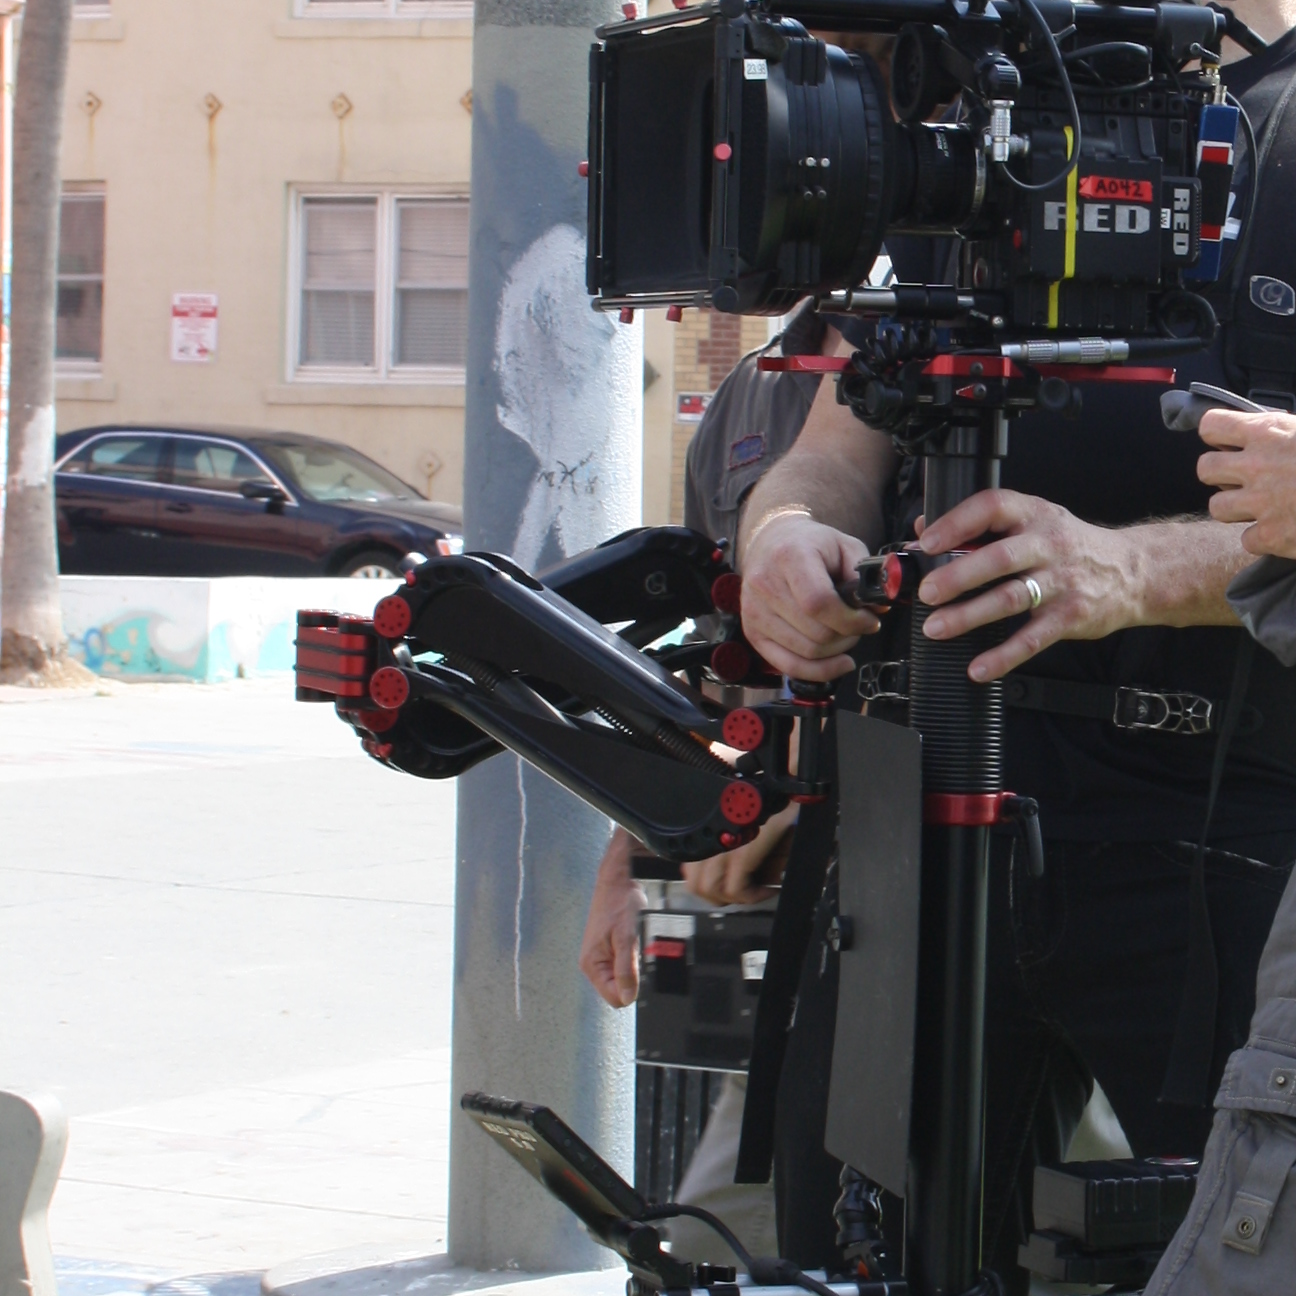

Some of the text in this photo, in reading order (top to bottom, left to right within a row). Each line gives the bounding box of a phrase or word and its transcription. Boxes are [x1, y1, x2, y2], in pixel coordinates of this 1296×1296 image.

[1095, 181, 1144, 197] A042
[1044, 201, 1150, 234] RED
[1173, 188, 1190, 255] RED
